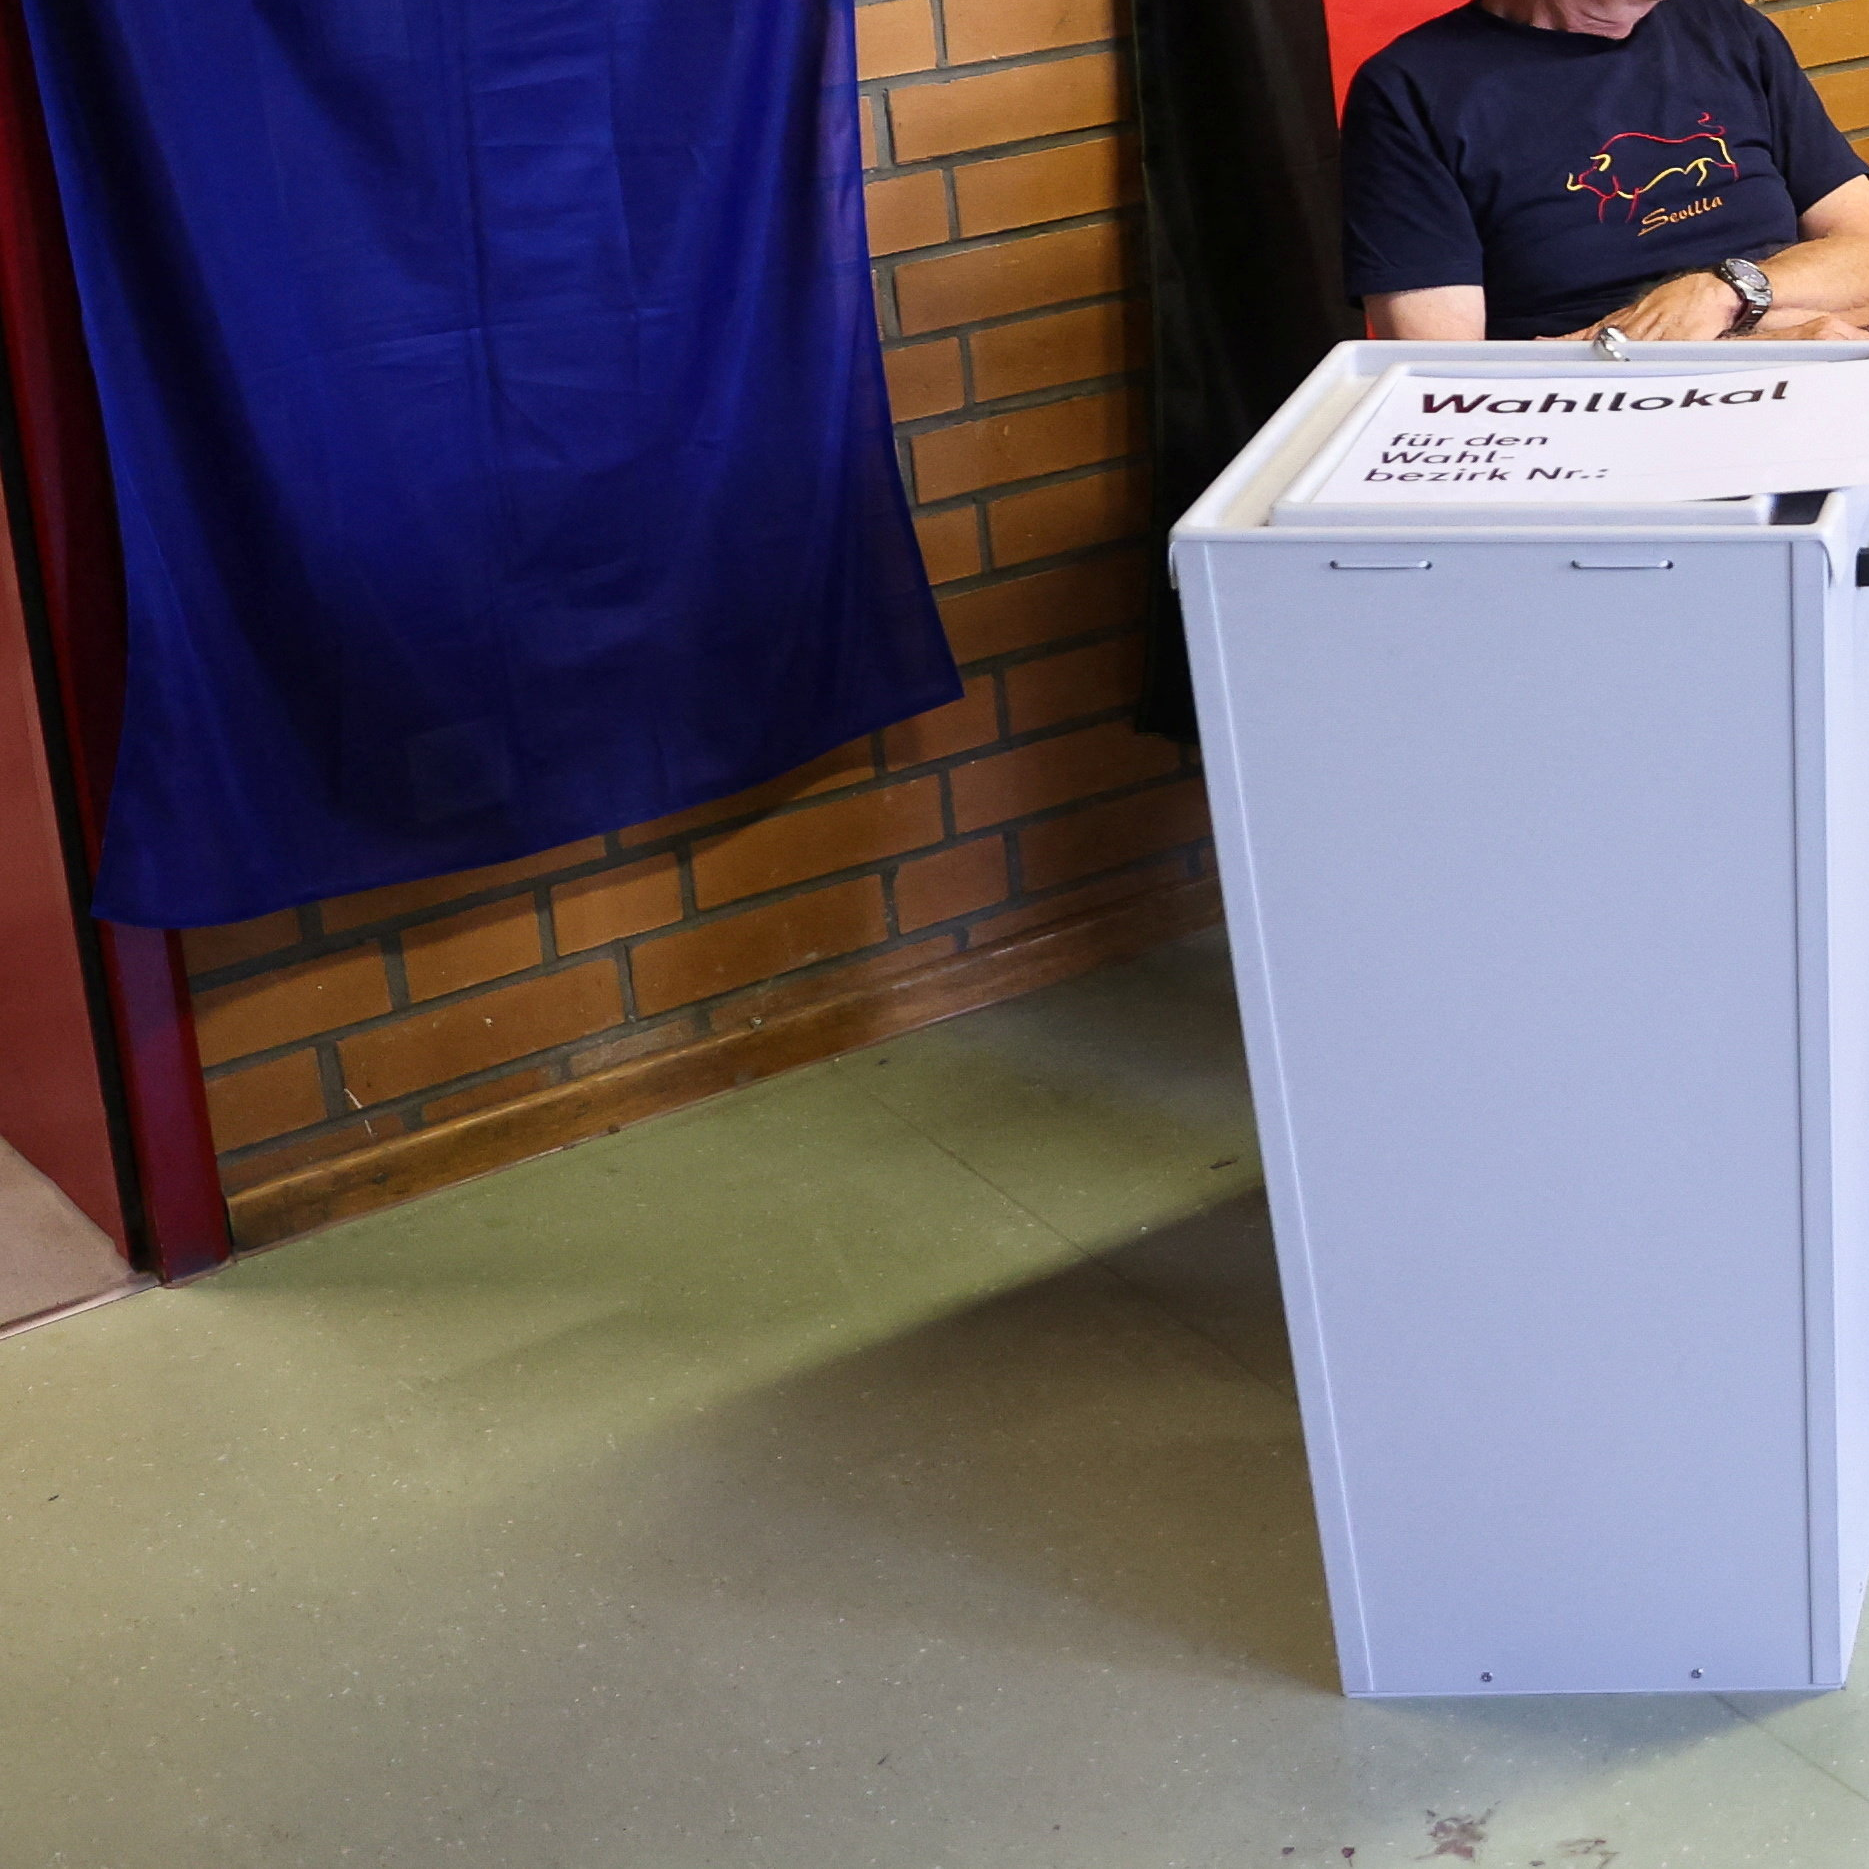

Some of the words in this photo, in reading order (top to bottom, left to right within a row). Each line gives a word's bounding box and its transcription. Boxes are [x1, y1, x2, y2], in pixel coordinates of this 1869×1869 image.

[1637, 195, 1723, 236] Sevilla
[1421, 380, 1789, 414] Wahllokal
[1390, 432, 1454, 448] für
[1465, 432, 1548, 447] den
[1380, 451, 1515, 465] Wahl-
[1363, 468, 1509, 483] bezirk
[1527, 466, 1609, 482] Nr.:
